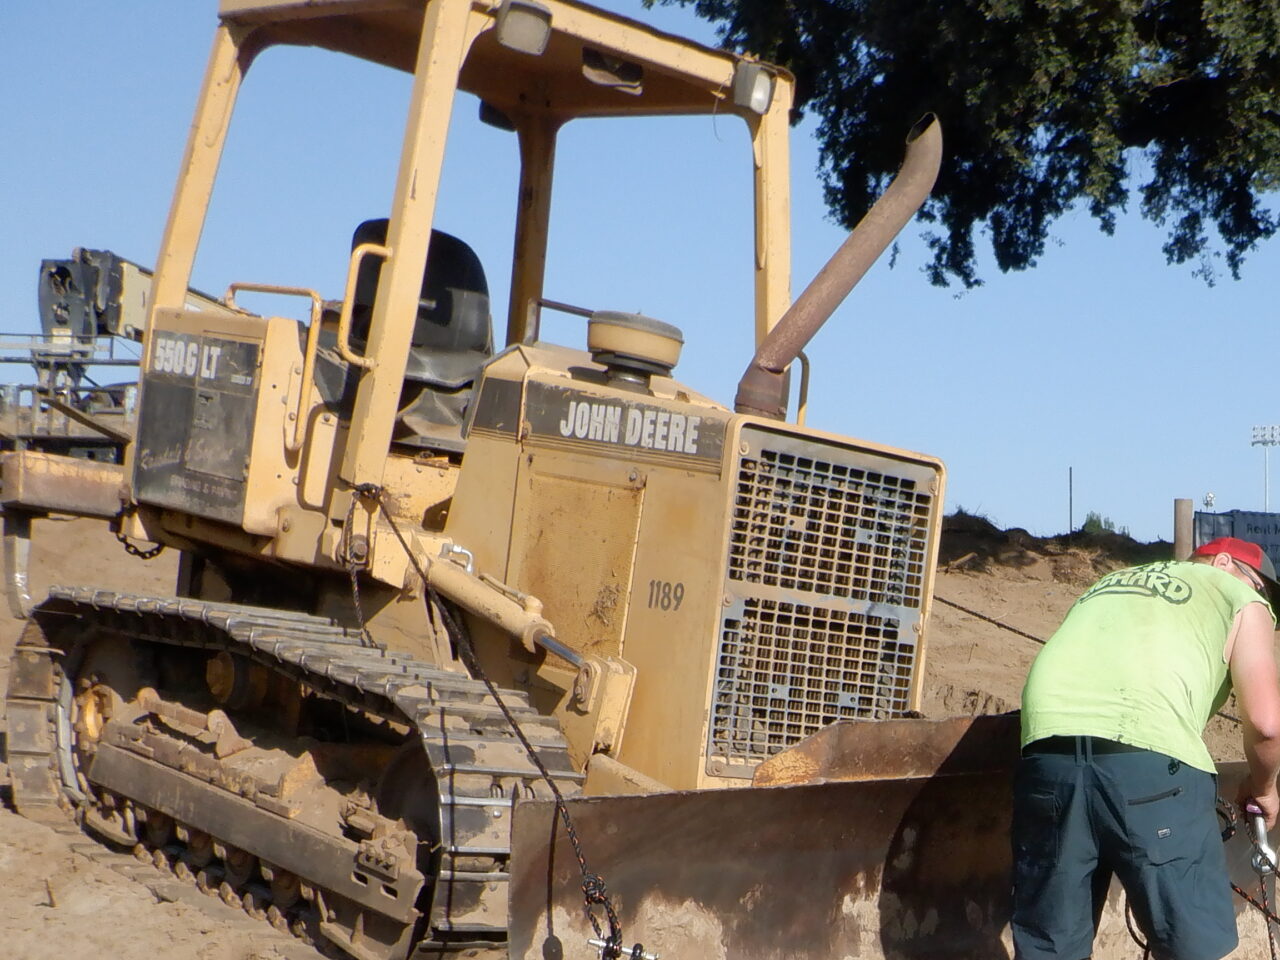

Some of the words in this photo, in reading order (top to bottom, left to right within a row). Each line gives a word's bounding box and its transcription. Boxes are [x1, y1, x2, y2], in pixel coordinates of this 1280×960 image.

[201, 345, 221, 379] LT
[560, 401, 622, 443] JOHN
[624, 408, 701, 454] DEERE
[648, 579, 685, 611] 1189
